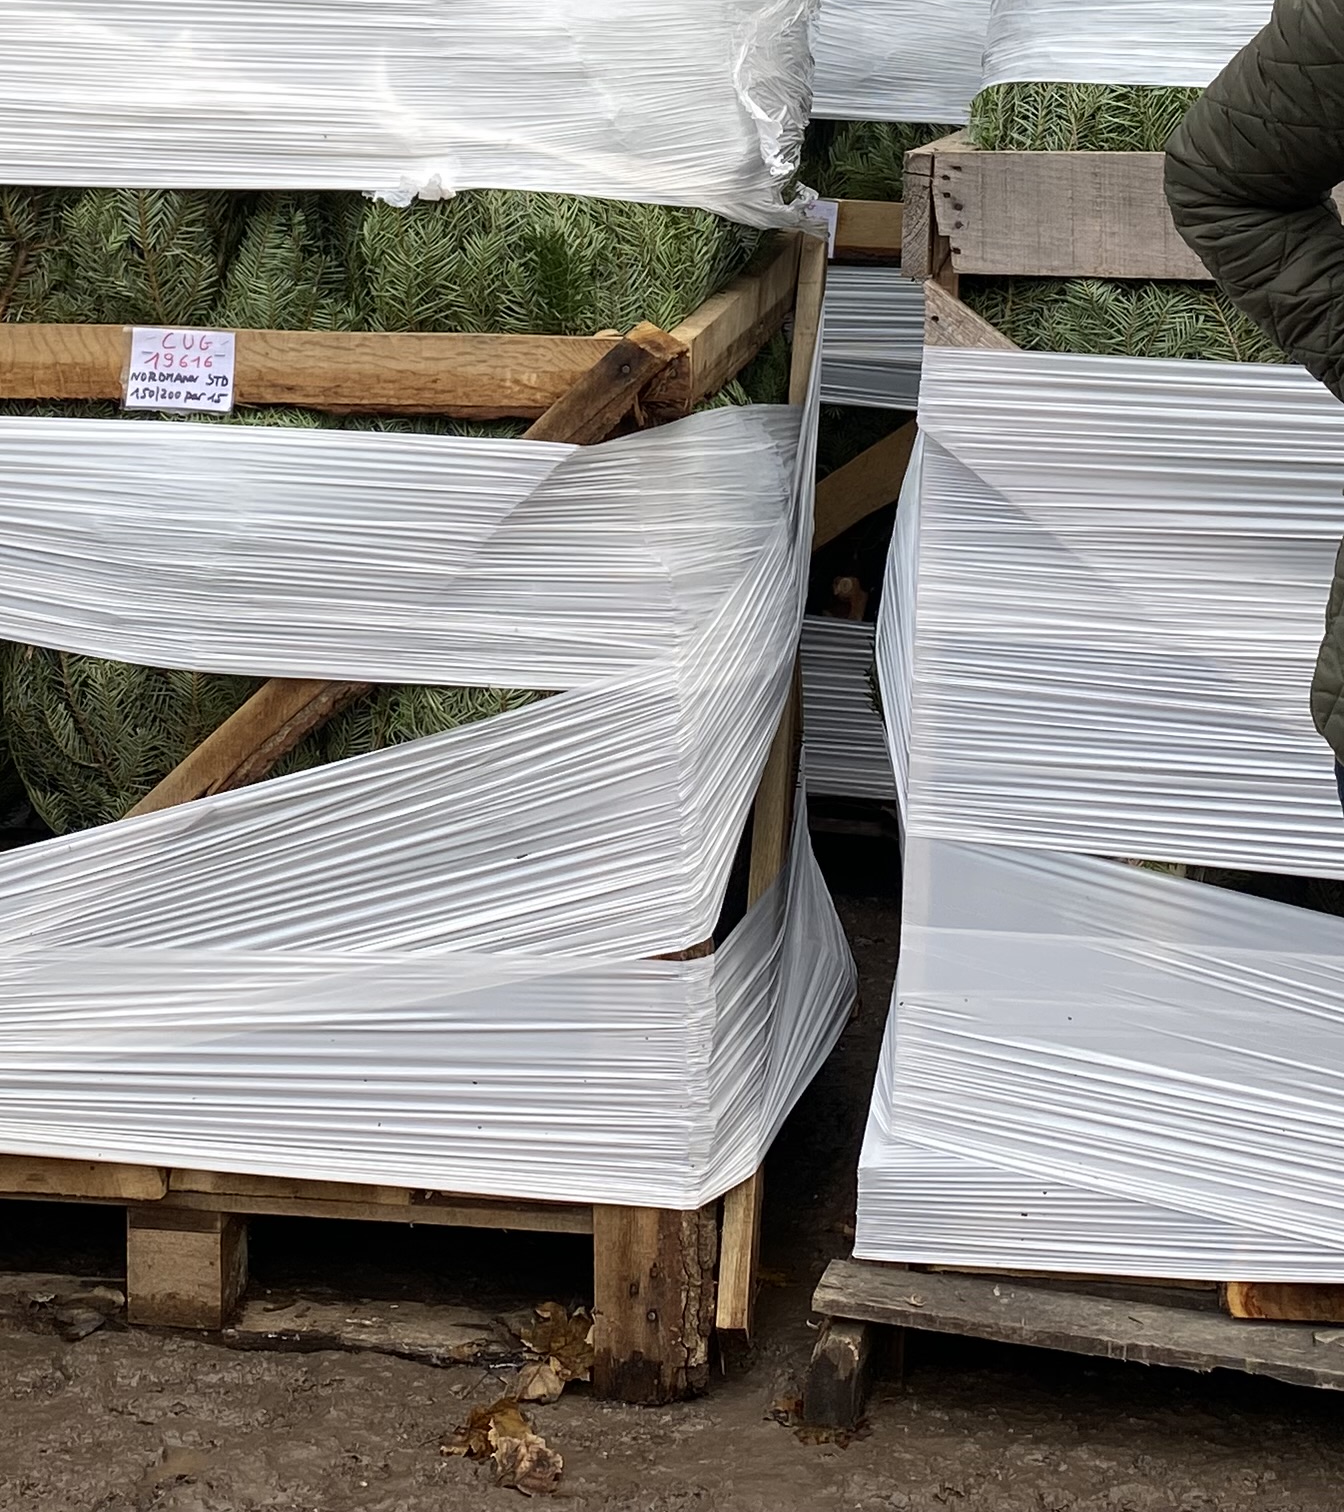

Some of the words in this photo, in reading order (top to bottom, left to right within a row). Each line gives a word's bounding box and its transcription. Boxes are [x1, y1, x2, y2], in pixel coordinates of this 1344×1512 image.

[143, 352, 213, 370] 19616
[205, 373, 229, 387] STD
[207, 392, 229, 404] 15
